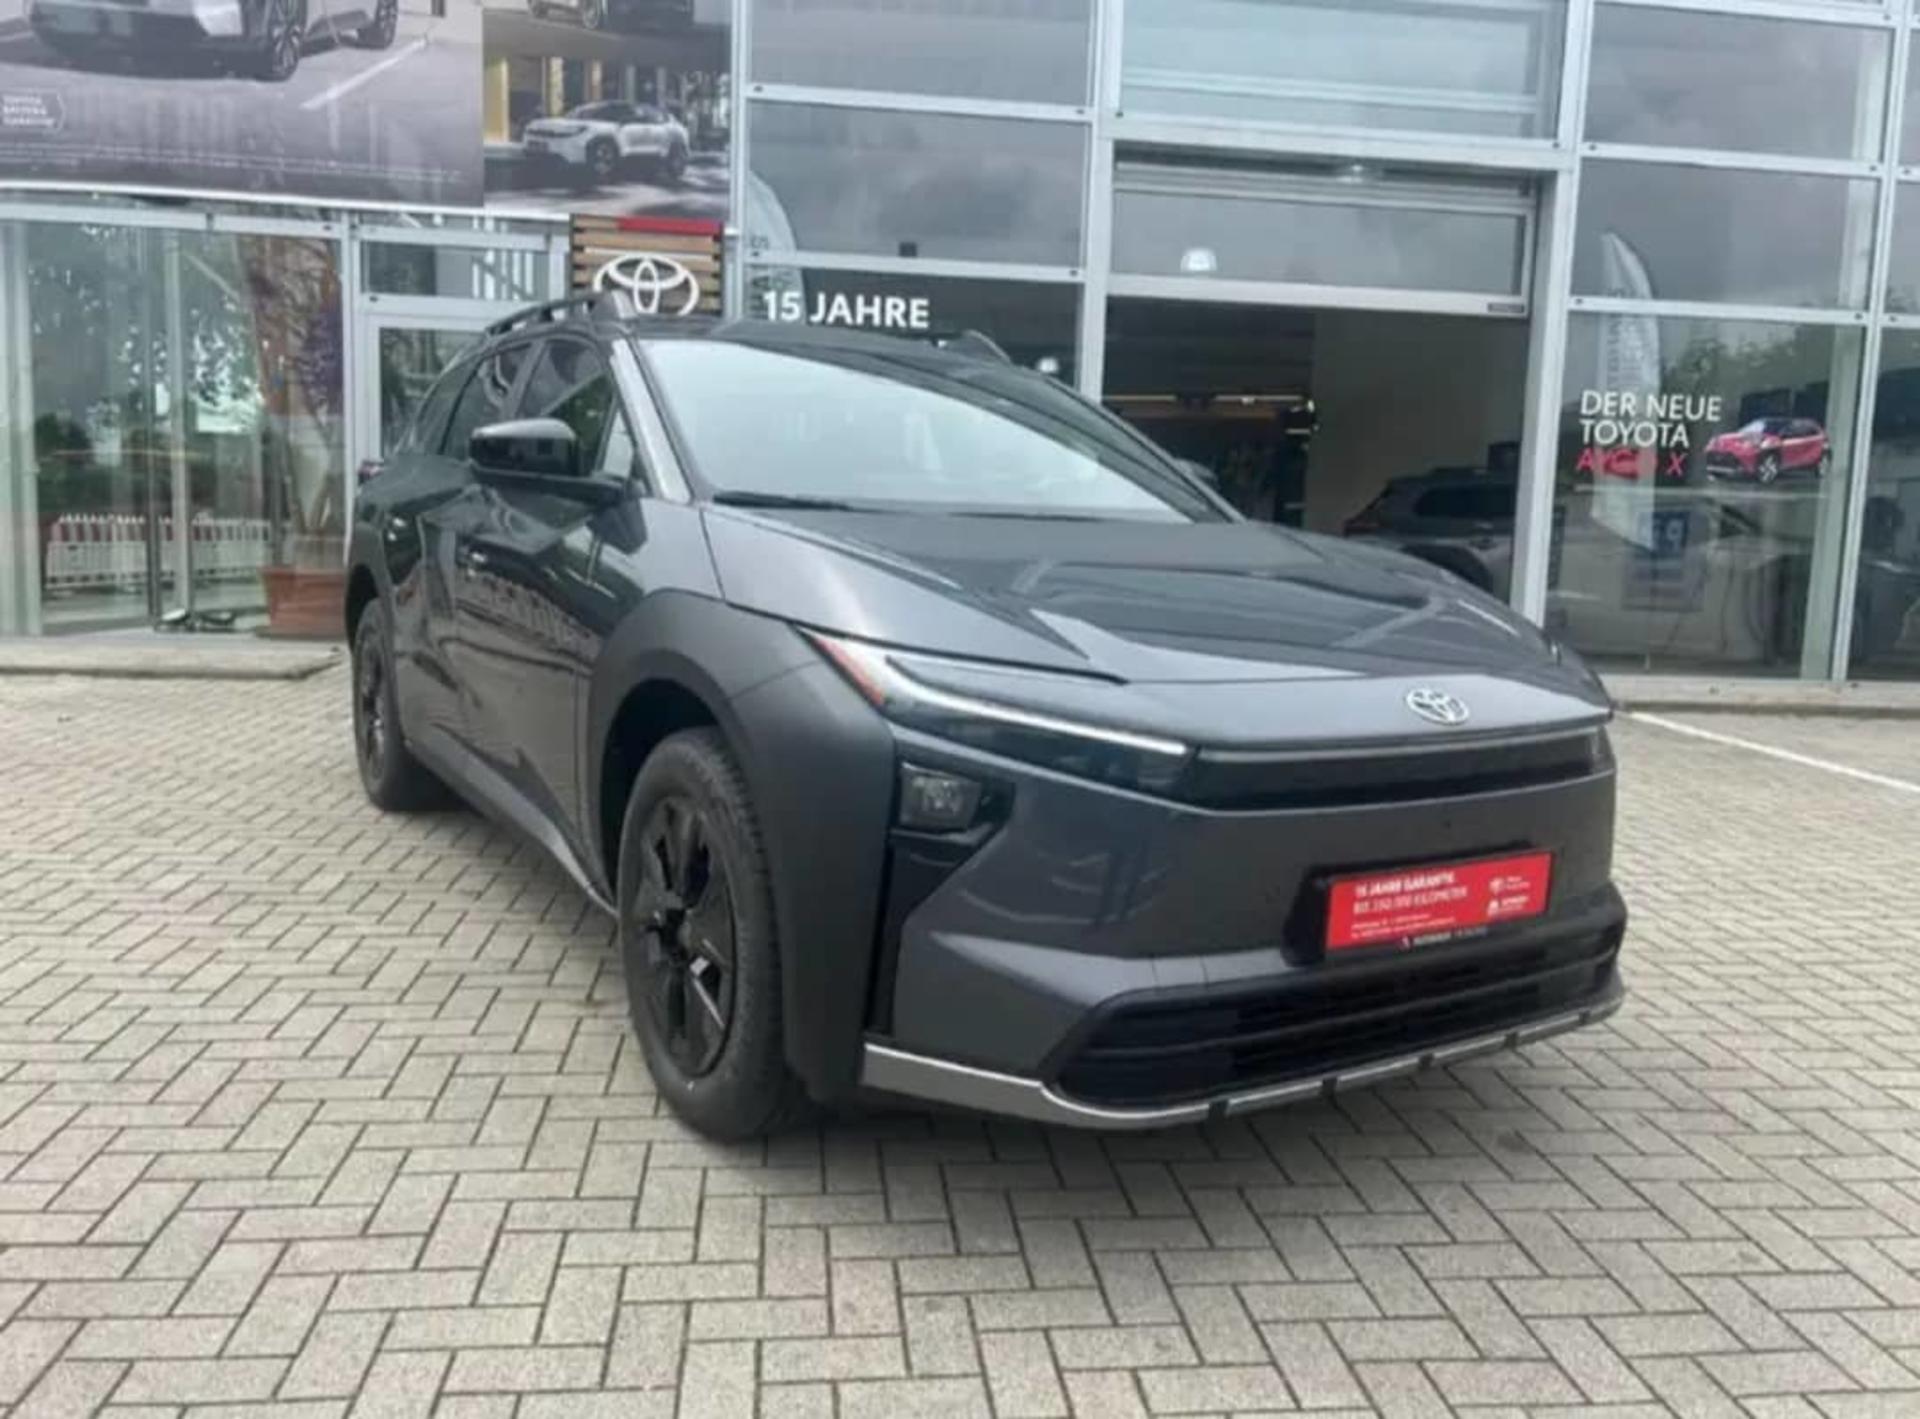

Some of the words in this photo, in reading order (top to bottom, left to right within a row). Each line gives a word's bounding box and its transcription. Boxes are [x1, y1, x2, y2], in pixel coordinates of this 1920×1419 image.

[764, 290, 801, 321] 15
[809, 291, 930, 329] JAHRE
[1580, 389, 1636, 417] DER
[1646, 394, 1722, 421] NEUE
[1579, 418, 1690, 448] TOYOTA
[1665, 452, 1688, 476] X
